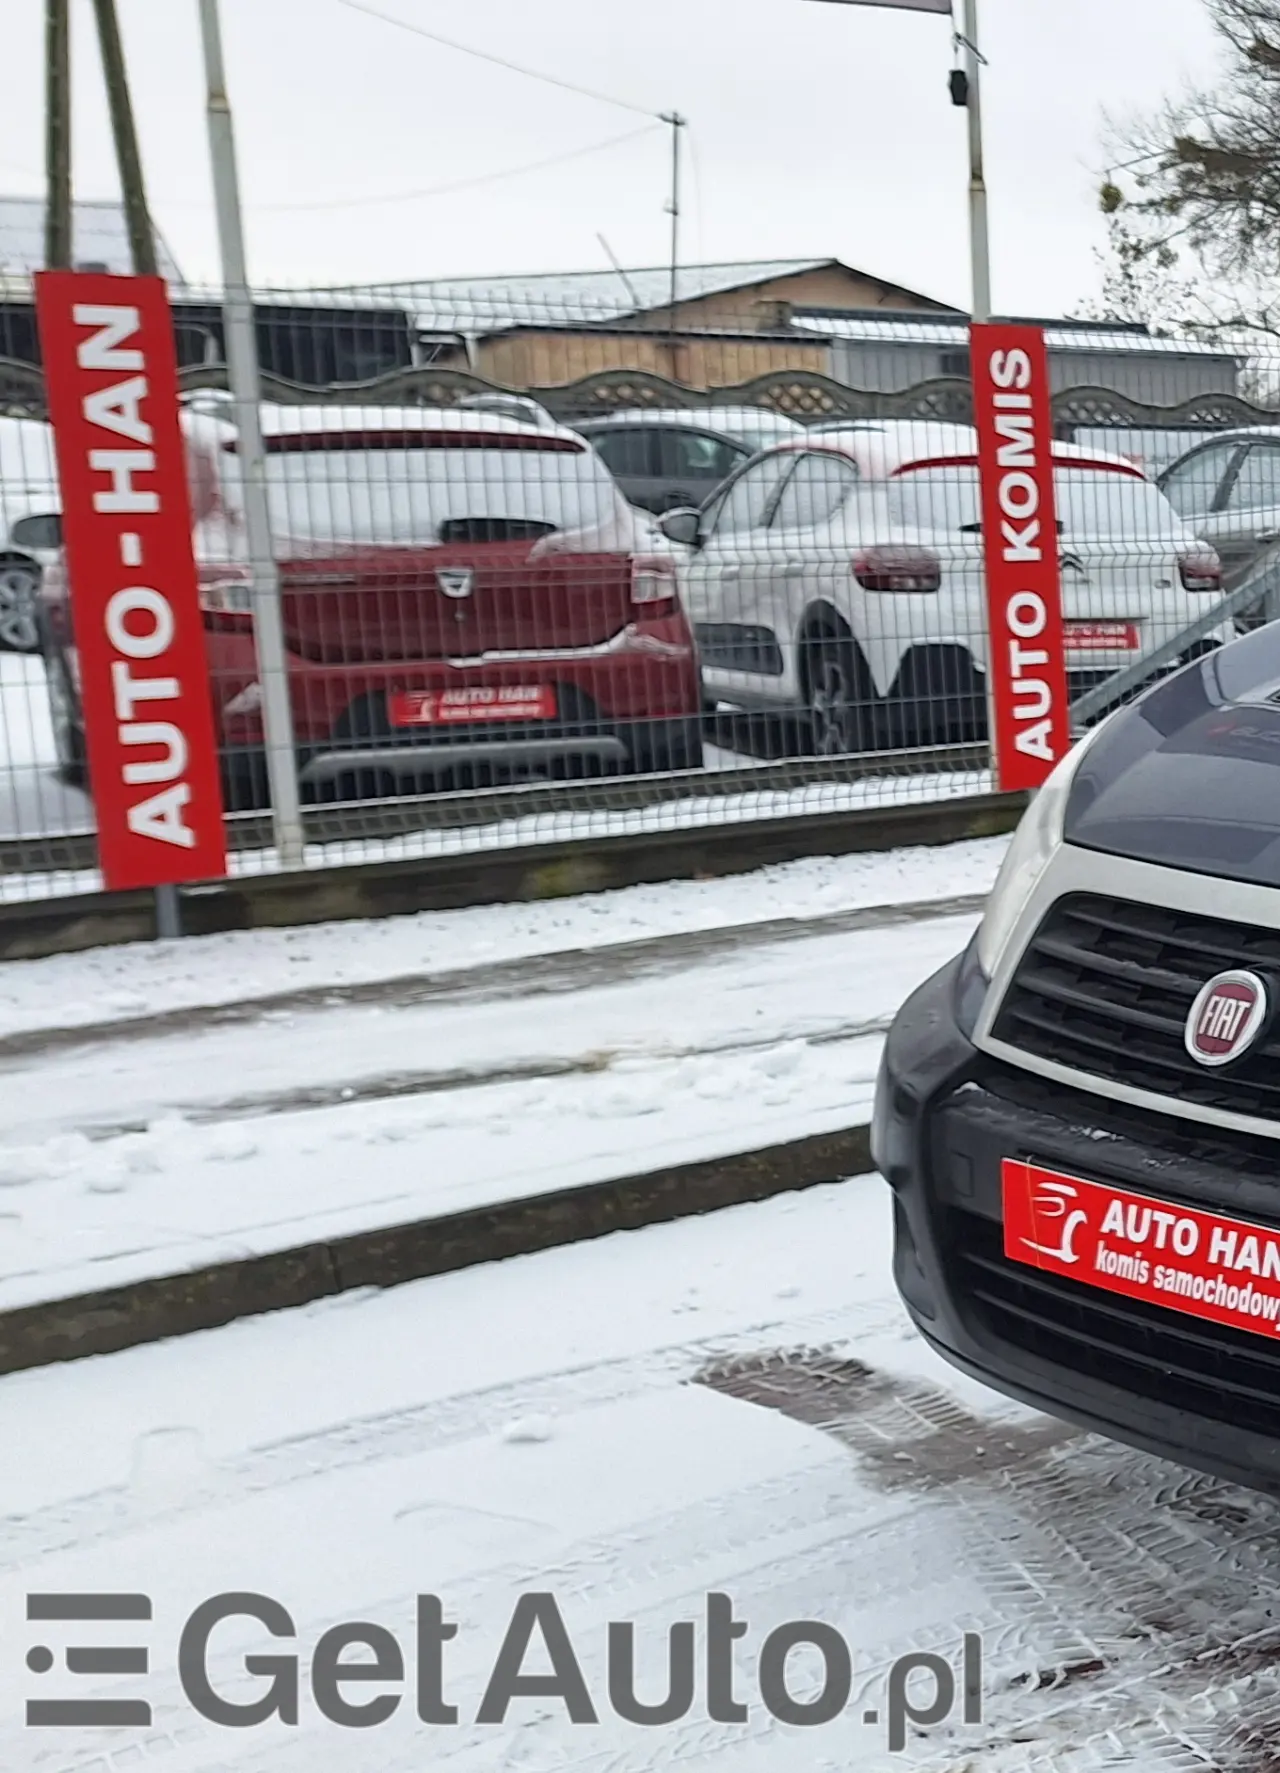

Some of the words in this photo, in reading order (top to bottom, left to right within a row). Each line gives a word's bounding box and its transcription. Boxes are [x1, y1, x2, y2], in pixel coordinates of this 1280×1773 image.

[989, 347, 1042, 562] KOMIS
[1005, 590, 1054, 761] AUTO
[1197, 994, 1253, 1042] FIAT
[1099, 1198, 1199, 1256] AUTO
[1095, 1240, 1149, 1284] komis
